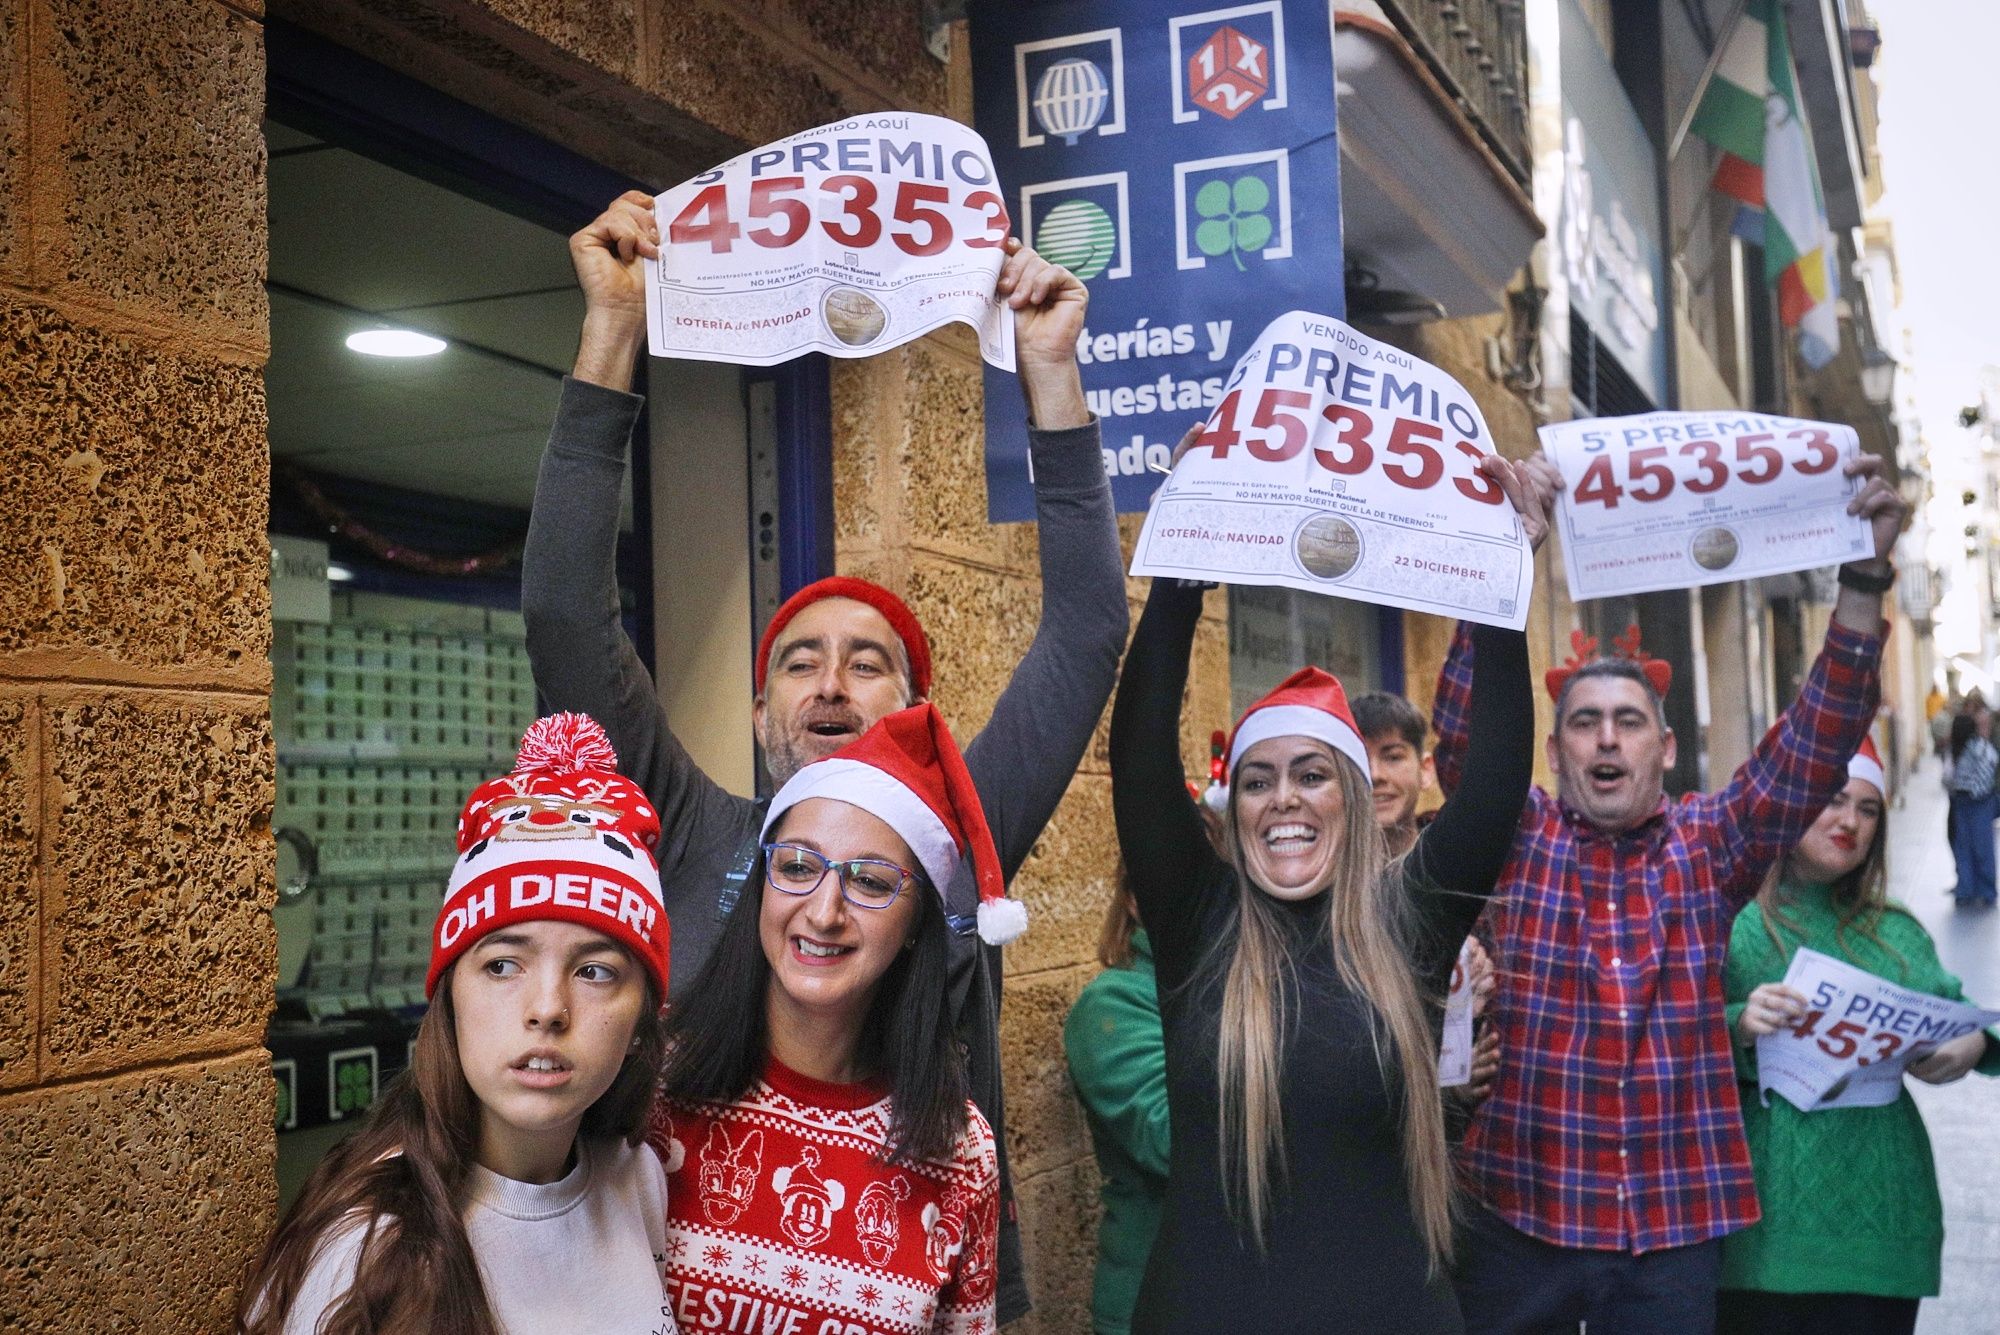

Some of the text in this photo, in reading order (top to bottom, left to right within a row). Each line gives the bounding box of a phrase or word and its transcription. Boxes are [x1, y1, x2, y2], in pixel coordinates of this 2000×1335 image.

[782, 117, 910, 144] VENDIDO AQUÍ
[751, 138, 993, 186] PREMIO
[669, 174, 1011, 257] 45353
[750, 279, 765, 287] NO
[767, 276, 786, 286] HAY
[789, 266, 820, 281] MAYOR
[821, 267, 854, 281] SUERTE
[856, 277, 874, 287] QUE
[876, 280, 888, 288] LA
[676, 307, 811, 331] LOTERÍA de NAVIDAD
[919, 296, 933, 307] 22
[1076, 318, 1232, 364] terías y
[1302, 321, 1414, 371] VENDIDO AQUÍ
[1086, 373, 1223, 418] uestas
[1265, 343, 1479, 440] PREMIO
[1101, 435, 1171, 477] ado
[1194, 388, 1505, 506] 45353
[1573, 429, 1839, 510] 45353
[1251, 491, 1269, 499] HAY
[1270, 492, 1302, 502] MAYOR
[1304, 495, 1337, 508] SUERTE
[1339, 503, 1358, 513] QUE
[1360, 507, 1371, 516] LA
[1374, 510, 1386, 519] DE
[1388, 513, 1435, 529] TENERNOS
[1161, 527, 1284, 545] LOTERÍA de NAVIDAD
[1394, 555, 1487, 581] 22 DICIEMBRE
[440, 873, 657, 949] OH DEER!
[1788, 1010, 1936, 1067] 453
[1844, 994, 1979, 1039] PREMIO
